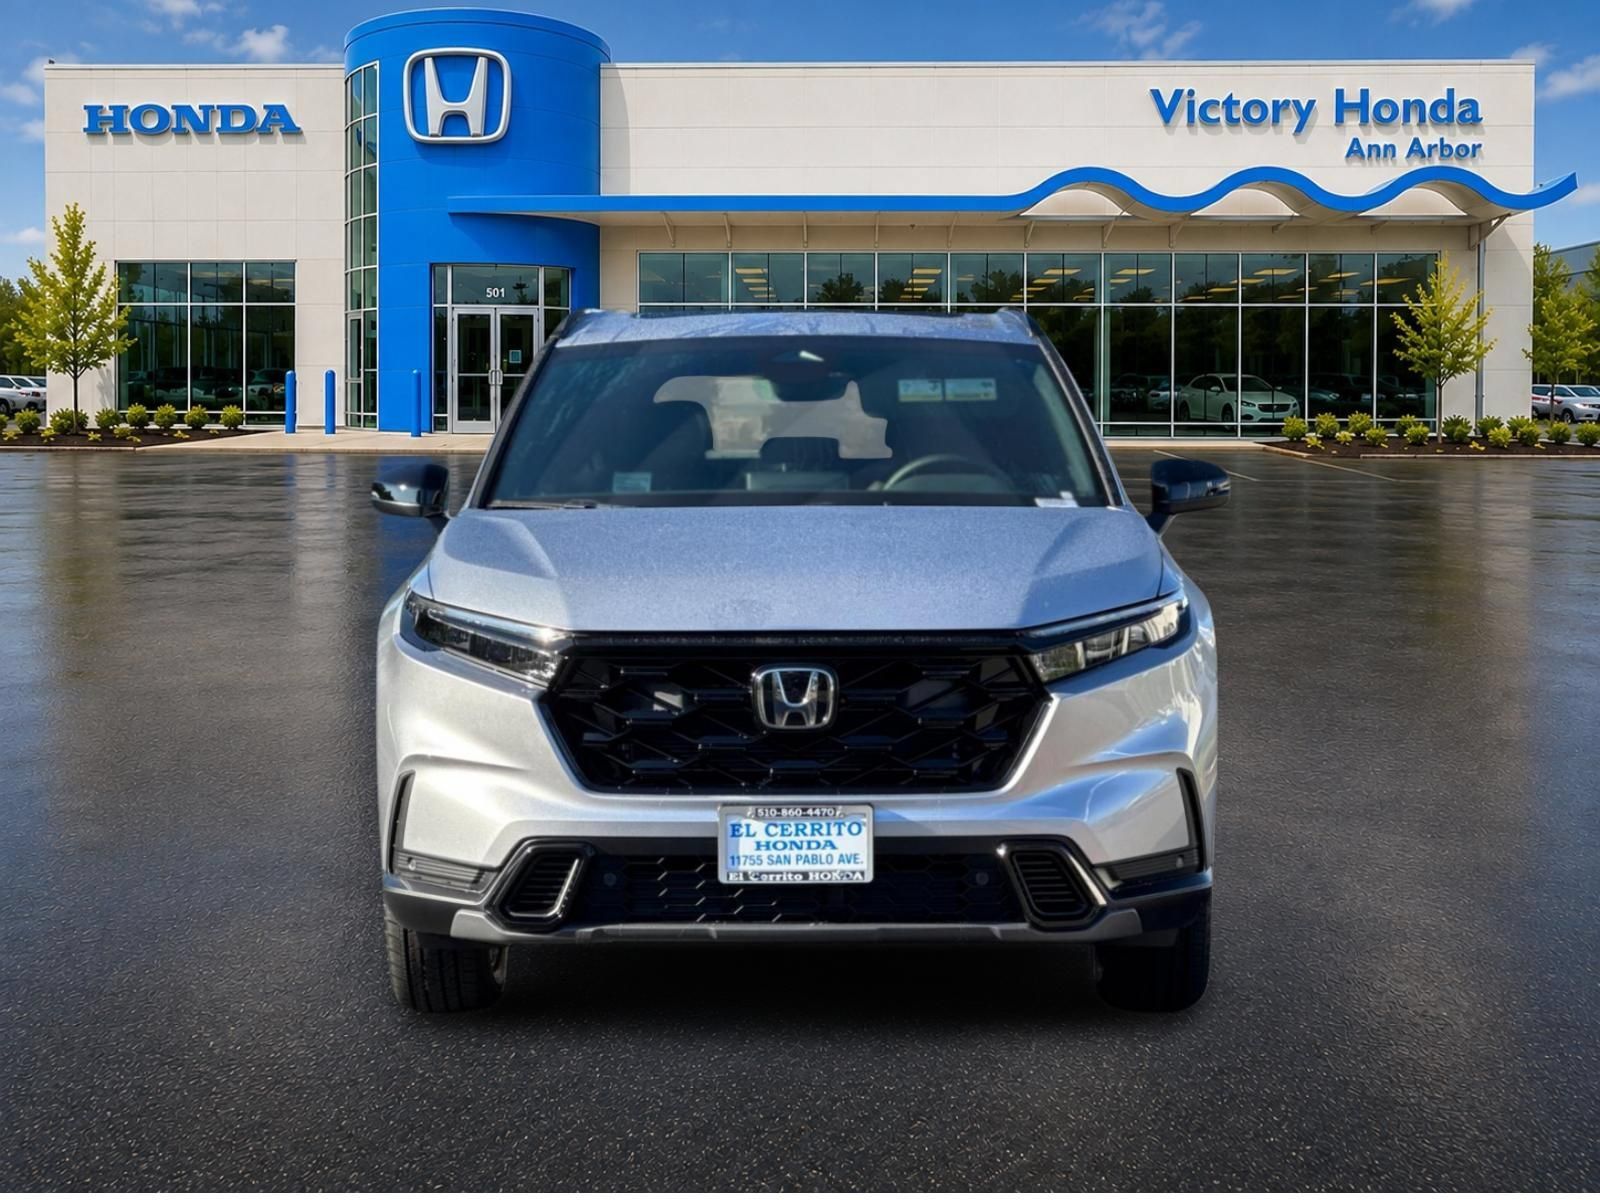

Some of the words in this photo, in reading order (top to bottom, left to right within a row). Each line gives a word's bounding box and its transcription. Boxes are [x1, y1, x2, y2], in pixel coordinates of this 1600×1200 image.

[1150, 88, 1316, 134] Victory
[1335, 88, 1483, 125] Honda
[83, 103, 302, 135] HONDA
[1346, 137, 1396, 158] Ann
[1406, 137, 1483, 158] Arbor
[486, 288, 505, 298] 501
[757, 808, 835, 817] 510-860-4470
[730, 822, 757, 838] EL
[764, 821, 863, 837] CERRITO
[755, 840, 838, 851] HONDA
[730, 854, 763, 866] 11755
[767, 854, 791, 865] SAN
[796, 853, 833, 865] PABLO
[838, 853, 864, 865] AVE.
[728, 872, 744, 881] El
[749, 871, 803, 881] Cerrito
